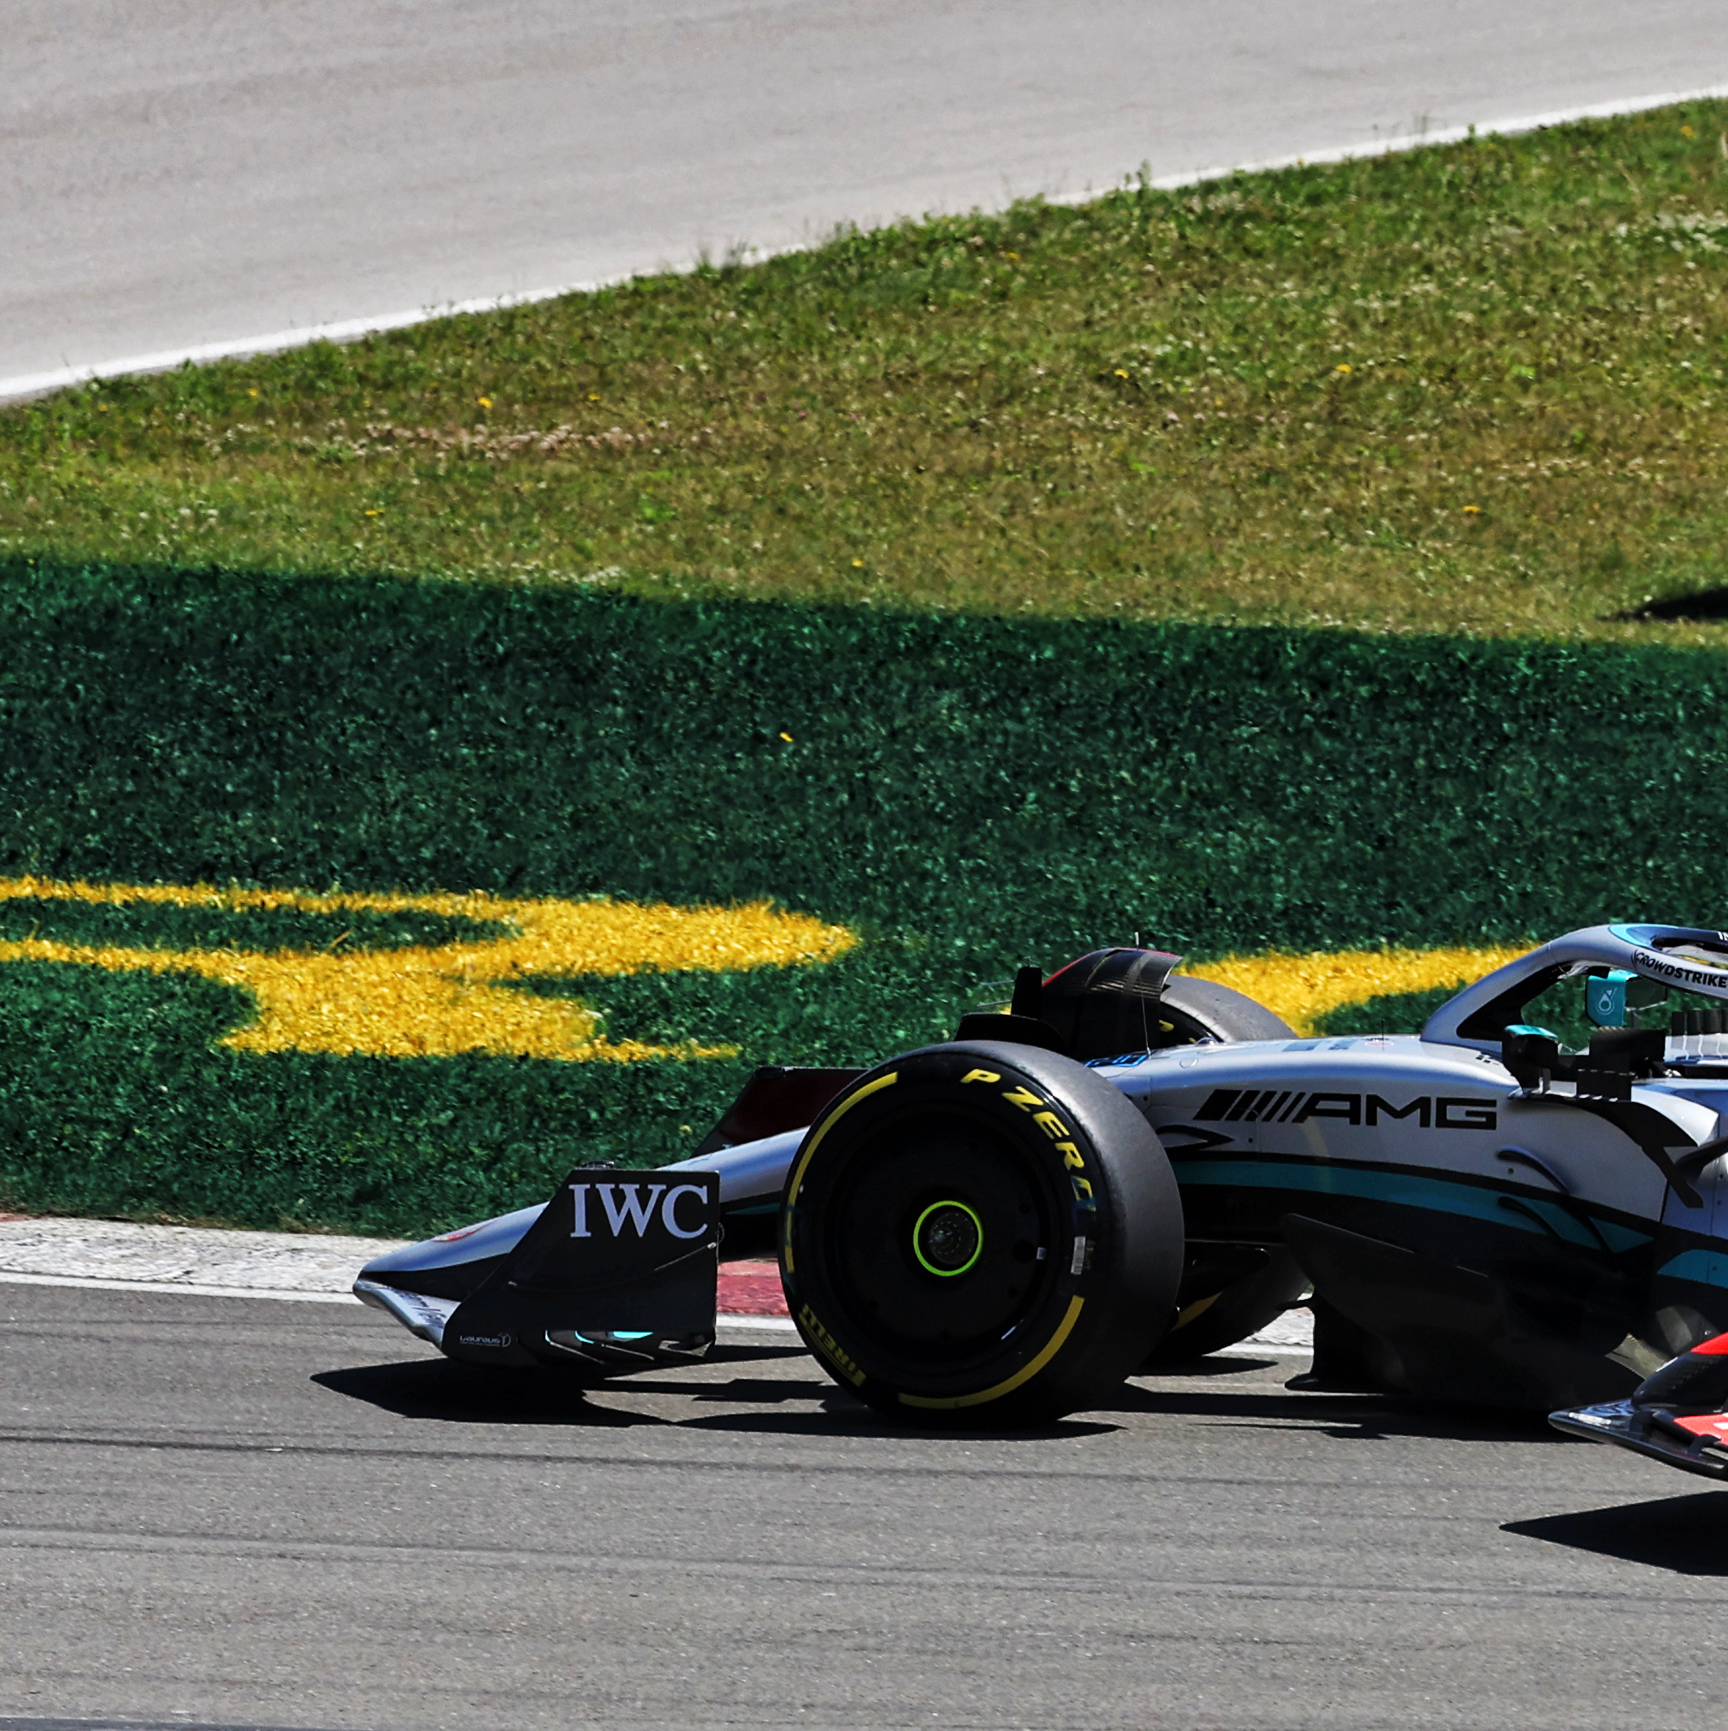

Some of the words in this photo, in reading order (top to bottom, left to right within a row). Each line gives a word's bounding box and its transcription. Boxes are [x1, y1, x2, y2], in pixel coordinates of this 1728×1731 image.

[1632, 949, 1728, 989] CROWDSTRIKE
[960, 1068, 1001, 1083] P
[1300, 1091, 1497, 1130] AMG
[568, 1183, 708, 1239] IWC
